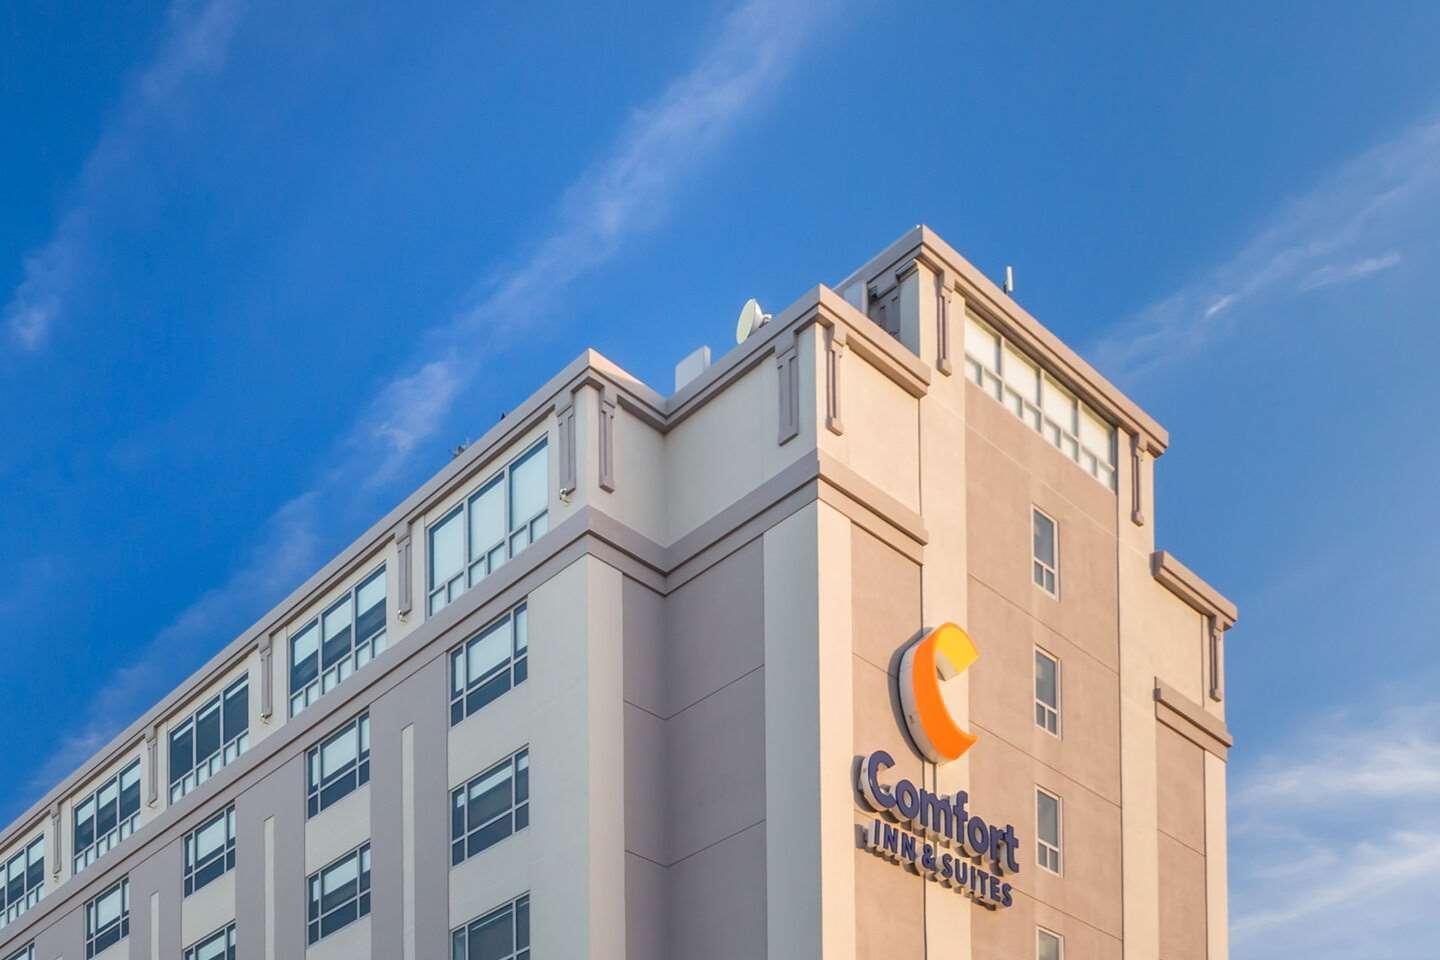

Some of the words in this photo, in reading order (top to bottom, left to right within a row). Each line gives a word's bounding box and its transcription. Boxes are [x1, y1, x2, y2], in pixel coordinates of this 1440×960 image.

[865, 750, 1020, 873] Comfort
[873, 819, 917, 861] INN
[921, 844, 937, 872] &
[941, 853, 1013, 908] SUITES
